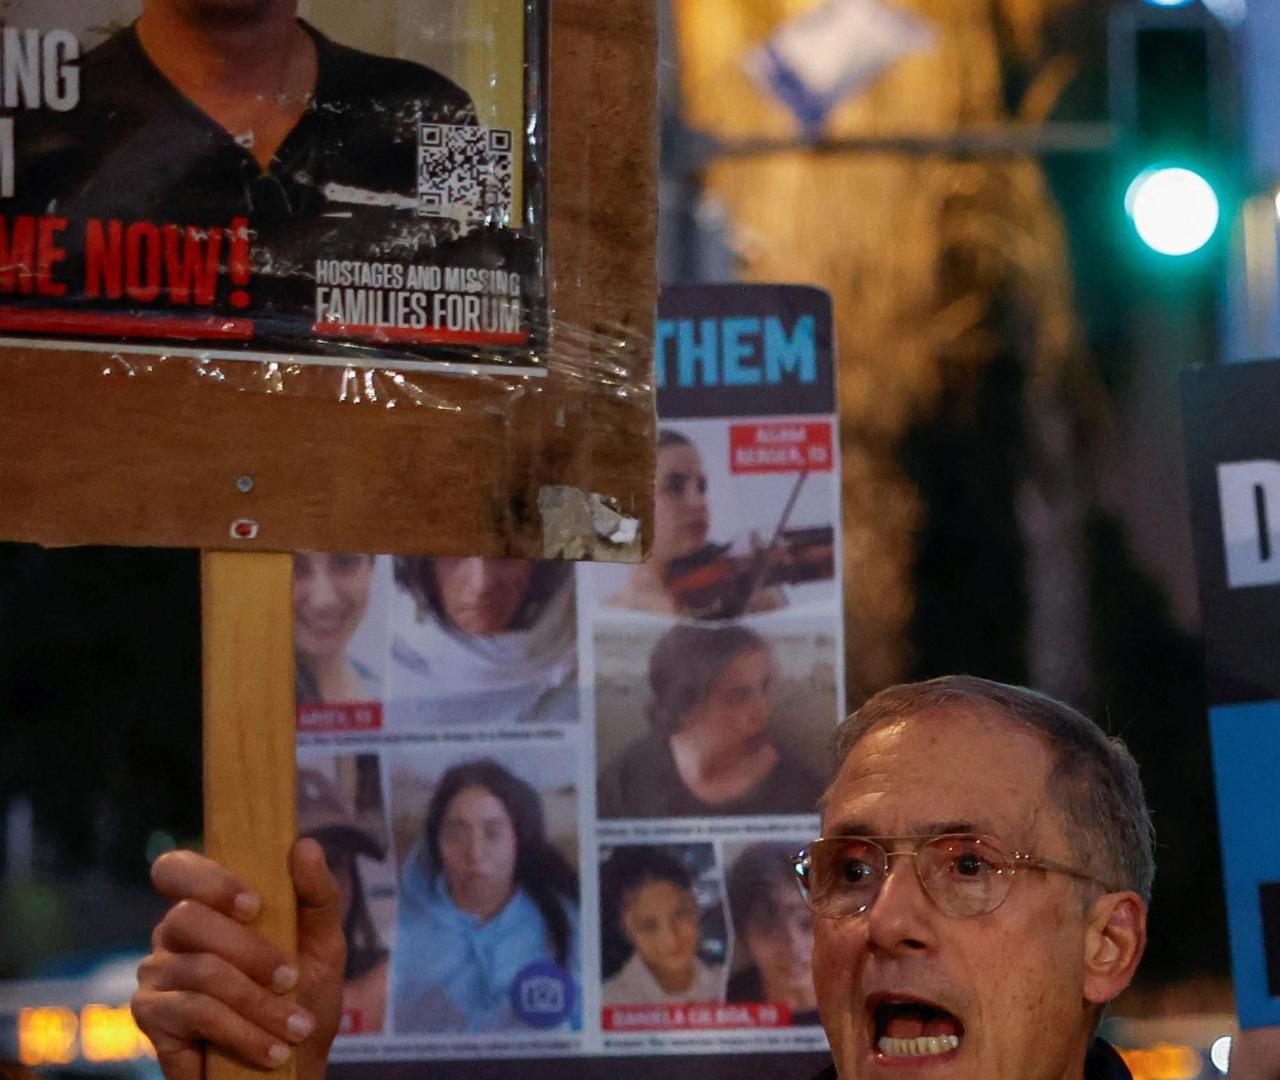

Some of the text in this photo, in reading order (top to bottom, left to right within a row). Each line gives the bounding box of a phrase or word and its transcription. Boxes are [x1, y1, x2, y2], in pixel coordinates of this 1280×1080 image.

[84, 216, 250, 309] NOW!
[316, 260, 521, 297] HOSTAGES AND MISSING
[316, 287, 521, 334] FAMILIES FORUM
[655, 314, 816, 388] THEM
